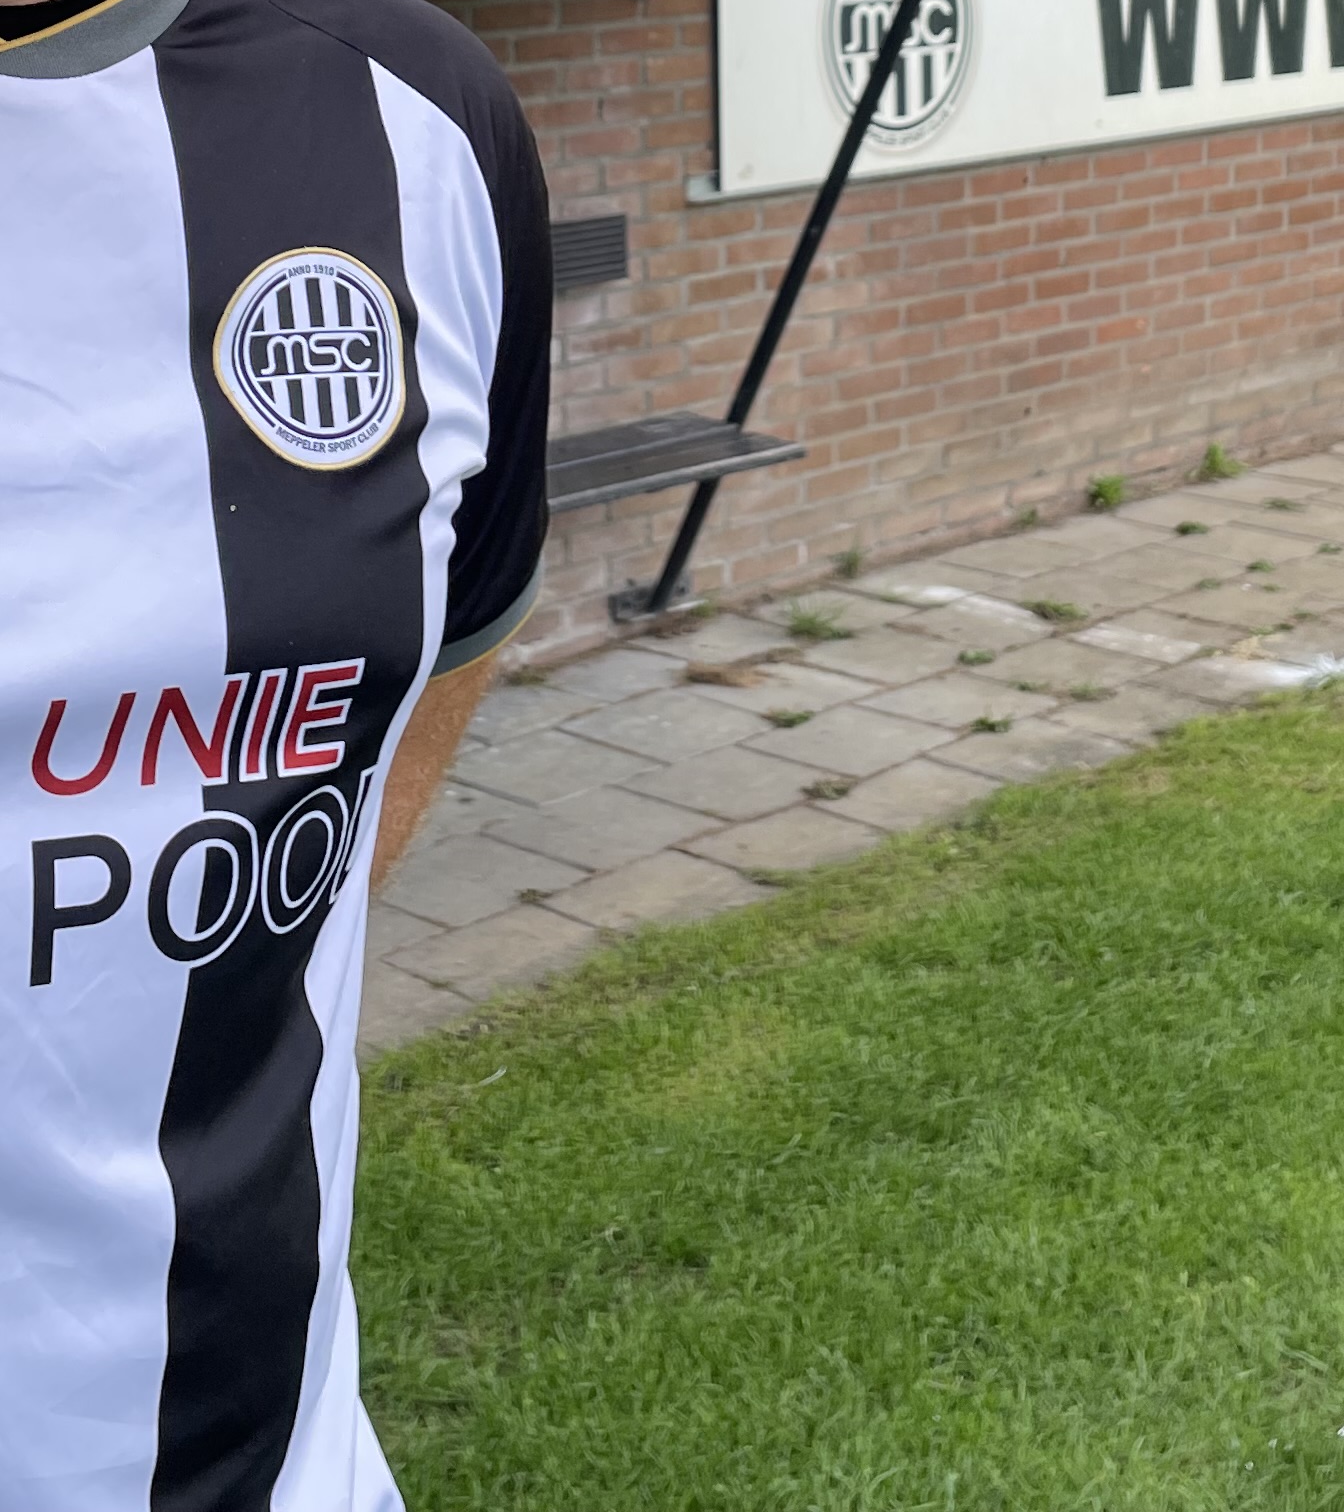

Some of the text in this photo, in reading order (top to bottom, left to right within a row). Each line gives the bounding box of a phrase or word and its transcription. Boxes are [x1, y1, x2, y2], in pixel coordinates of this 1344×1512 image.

[288, 263, 335, 278] ANNO 1910
[275, 422, 380, 453] MEPPELER SPORT CLUB
[31, 656, 366, 797] UNIE
